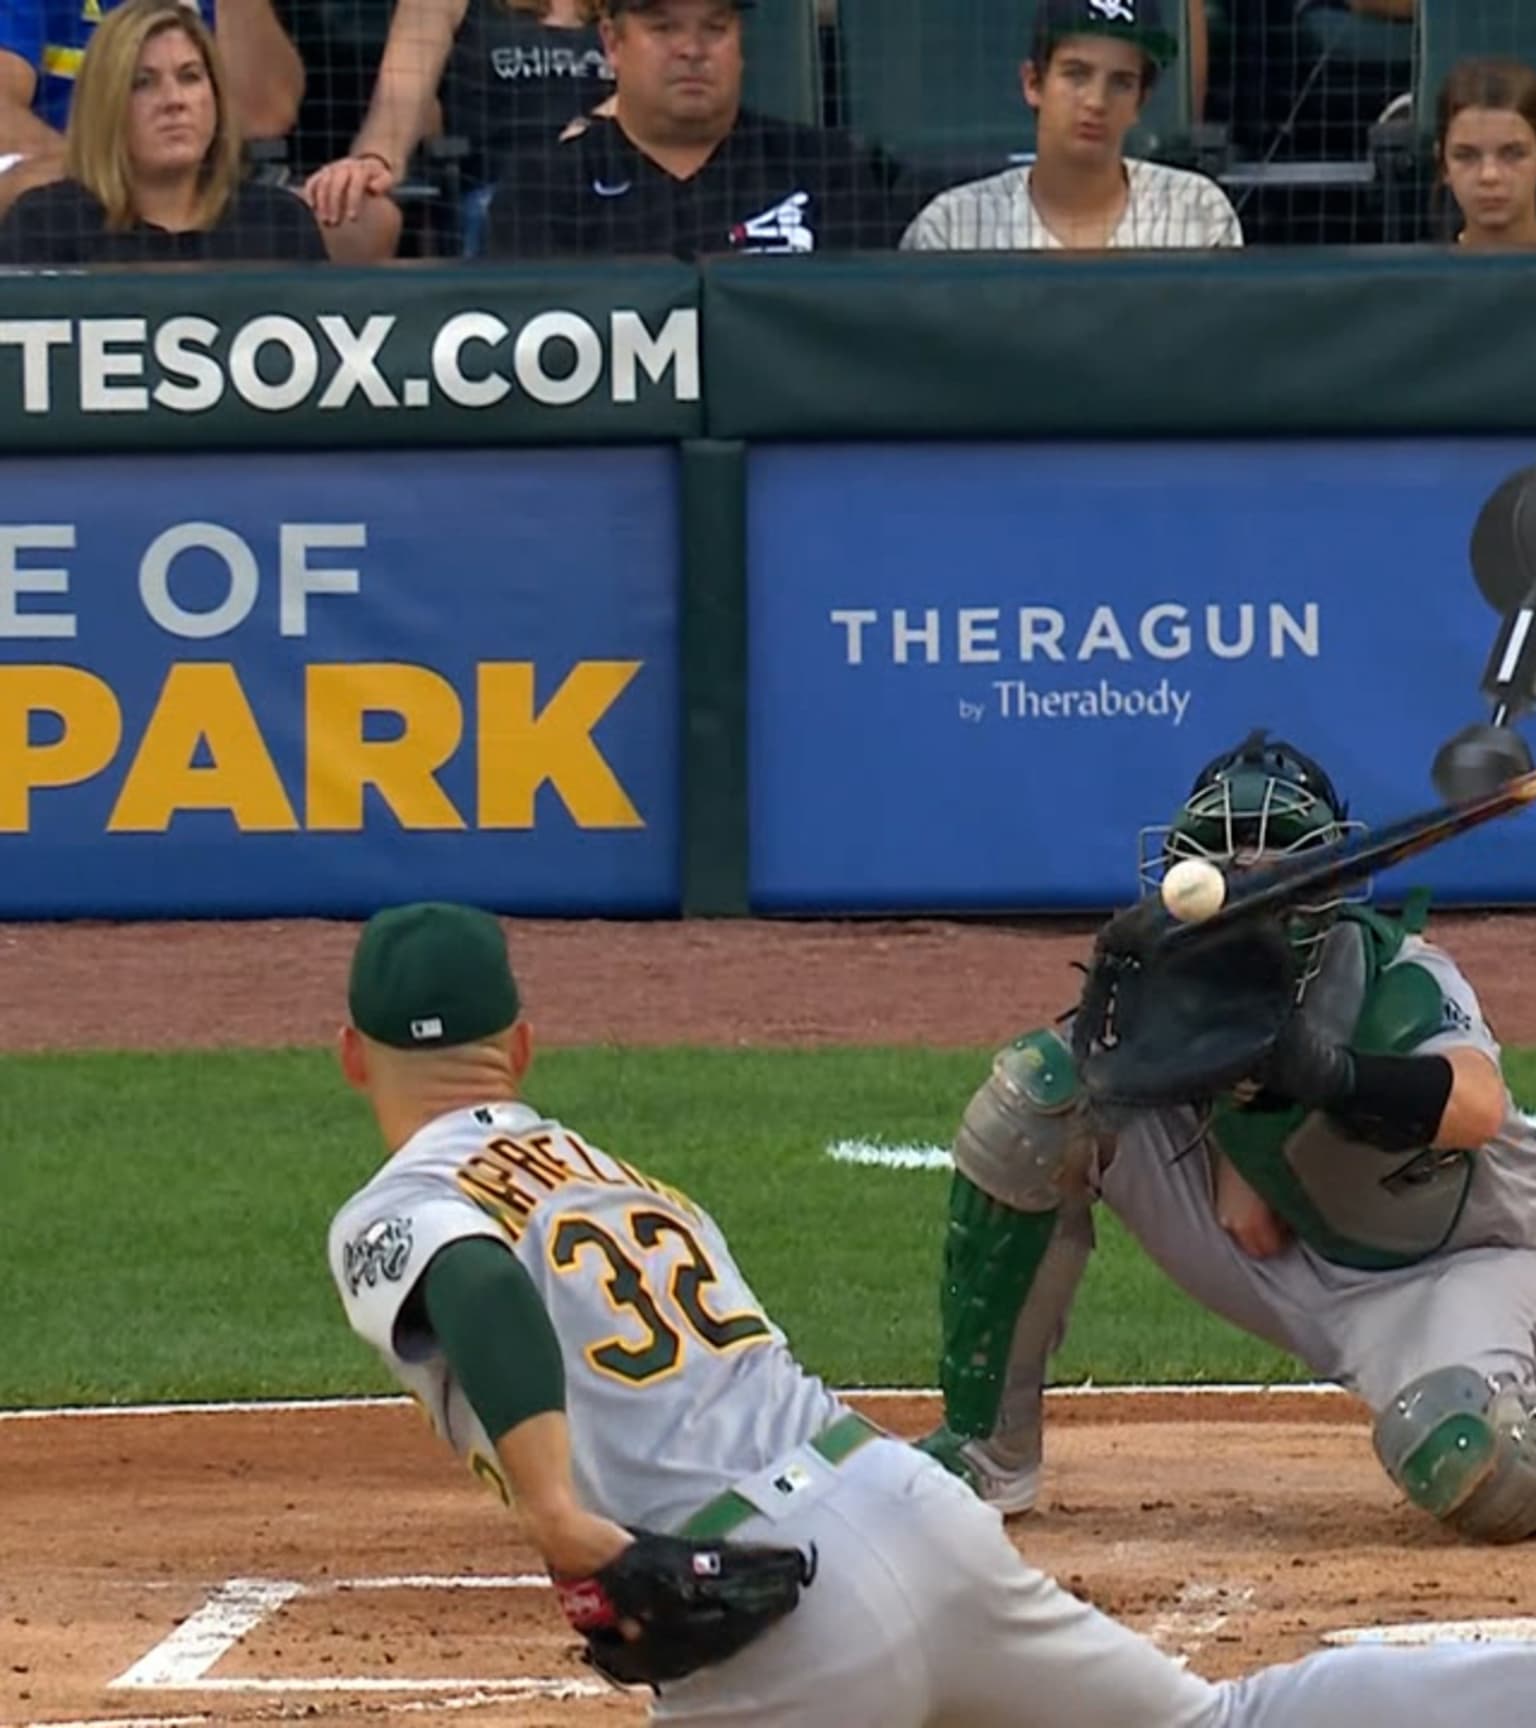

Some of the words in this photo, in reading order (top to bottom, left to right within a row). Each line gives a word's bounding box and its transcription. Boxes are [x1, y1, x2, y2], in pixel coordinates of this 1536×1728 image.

[0, 309, 700, 413] TESOX.COM
[138, 521, 367, 639] OF
[831, 602, 1319, 664] THERAGUN
[0, 661, 647, 833] PARK
[959, 699, 985, 722] by
[993, 679, 1191, 725] Therabody
[549, 1207, 772, 1389] 32
